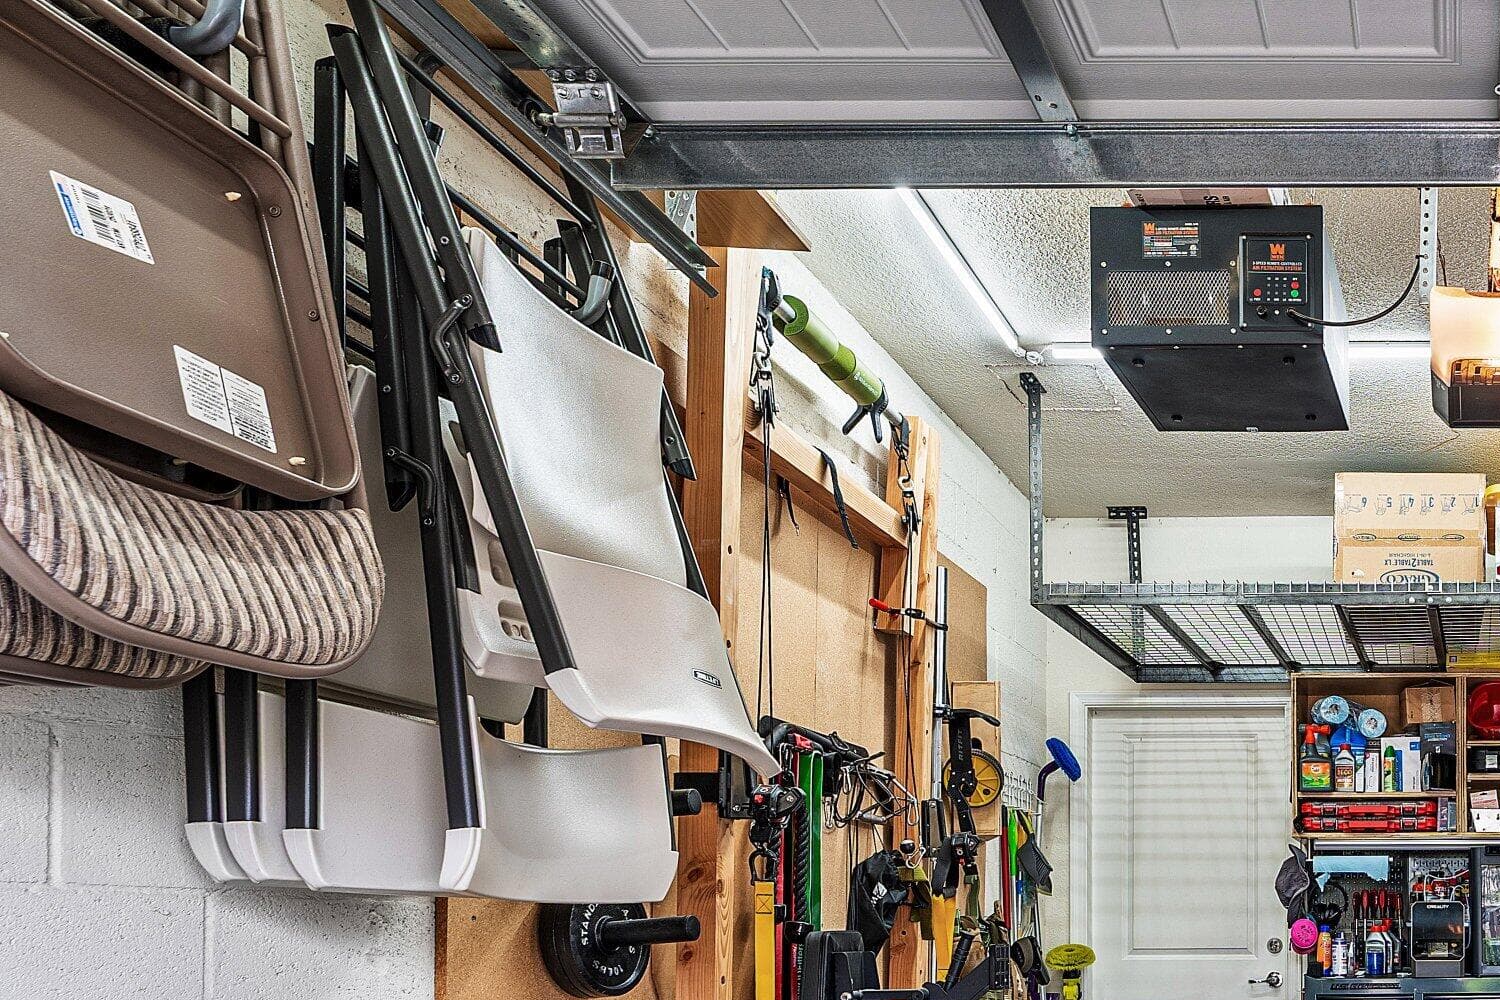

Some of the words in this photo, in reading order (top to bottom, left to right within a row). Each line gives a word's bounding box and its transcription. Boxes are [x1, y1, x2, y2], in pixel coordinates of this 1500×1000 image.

[1361, 496, 1367, 507] 6
[1386, 496, 1392, 507] 5
[1408, 496, 1414, 507] 4
[1429, 496, 1434, 507] 3
[1450, 496, 1456, 507] 2
